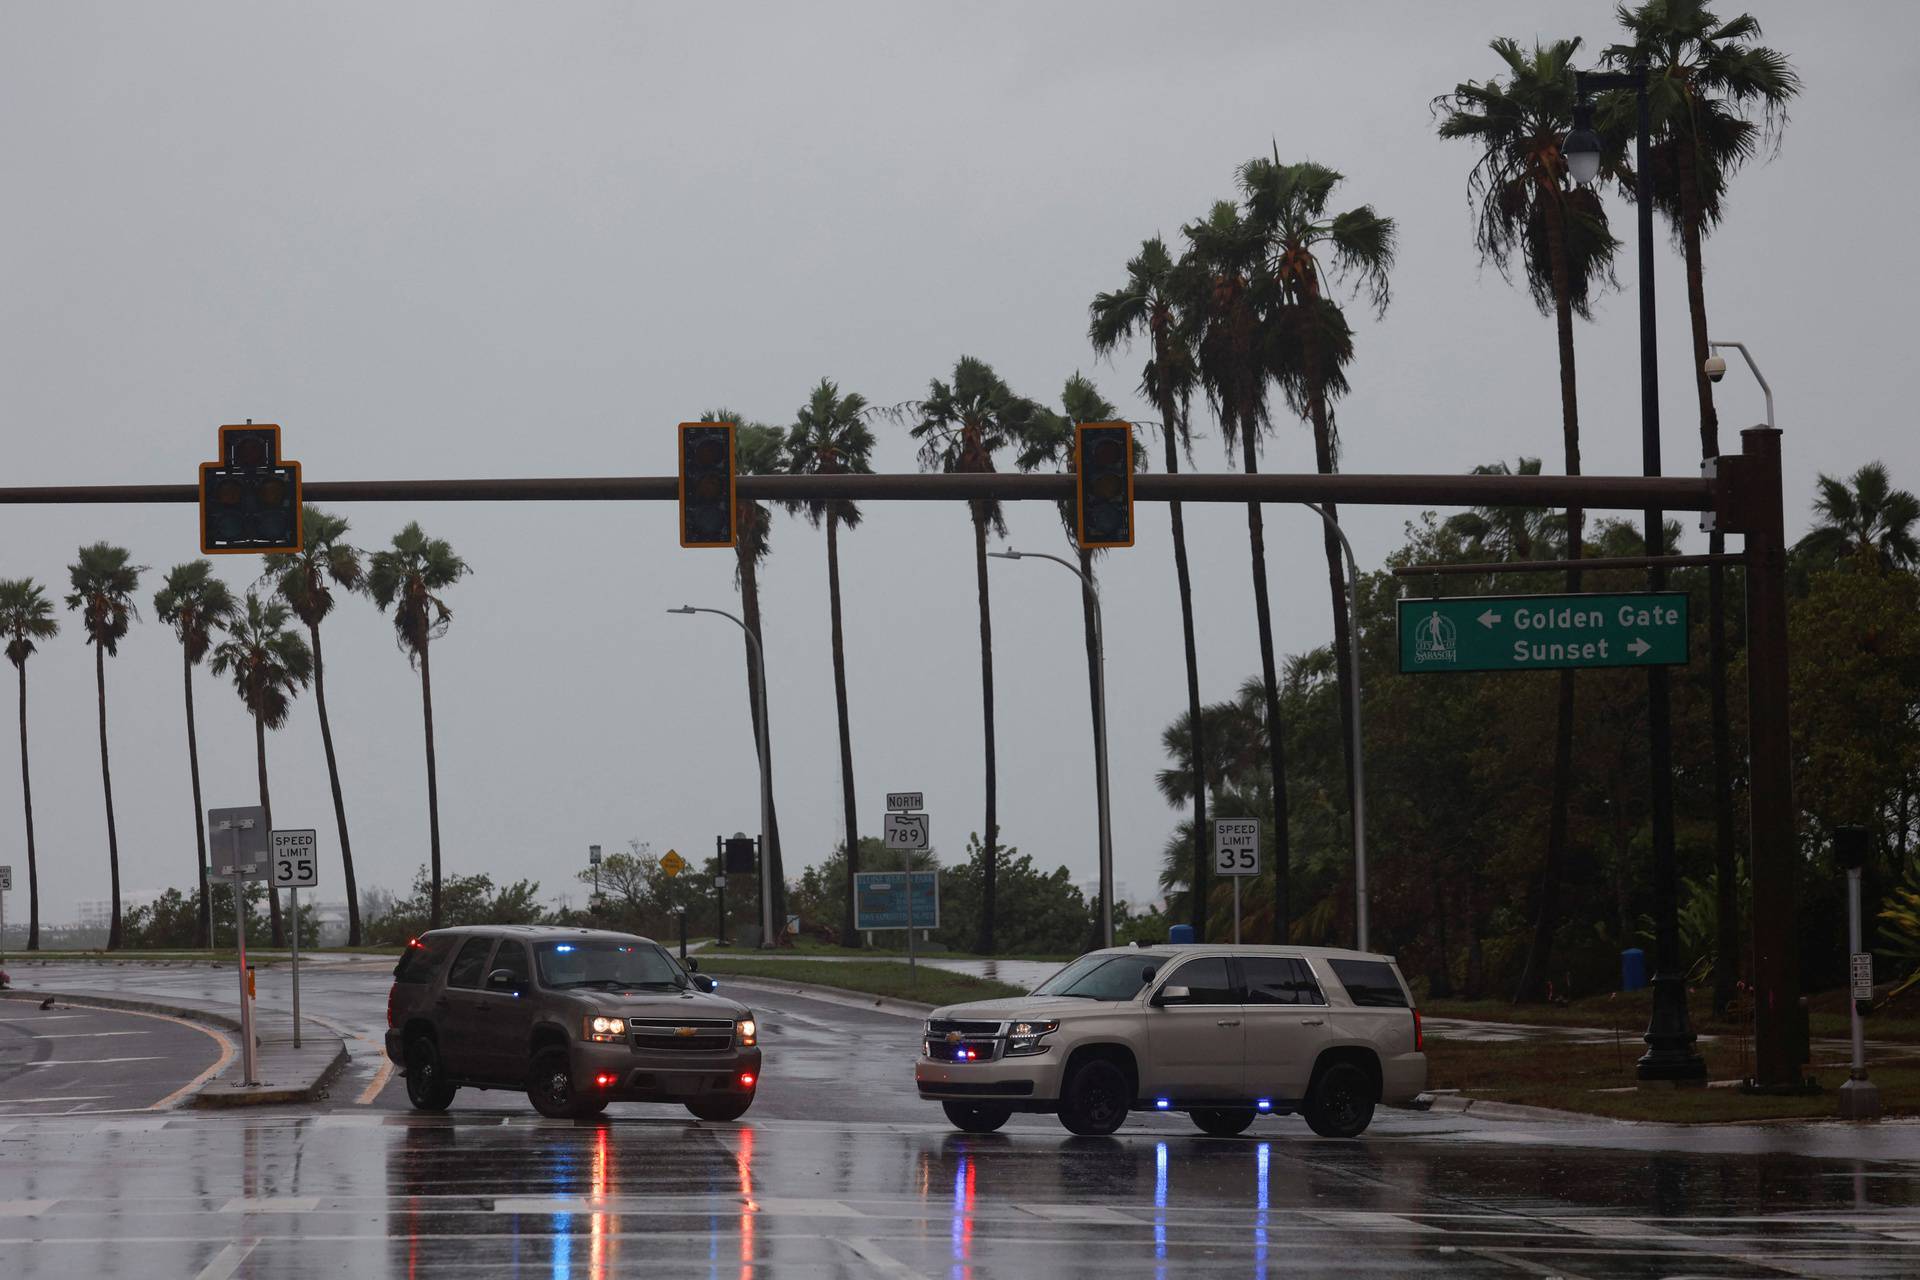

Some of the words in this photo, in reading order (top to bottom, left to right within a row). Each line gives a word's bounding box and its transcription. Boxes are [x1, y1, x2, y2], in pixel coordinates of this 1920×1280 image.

[1514, 608, 1603, 630] Golden
[1618, 605, 1679, 627] Gate
[1513, 638, 1608, 661] Sunset
[889, 797, 921, 807] NORTH
[1219, 825, 1256, 834] SPEED
[888, 829, 918, 841] 789
[276, 836, 313, 845] SPEED
[1222, 837, 1252, 845] LIMIT
[280, 848, 309, 857] LIMIT
[1219, 848, 1255, 869] 35
[277, 859, 313, 882] 35
[0, 879, 10, 888] 5
